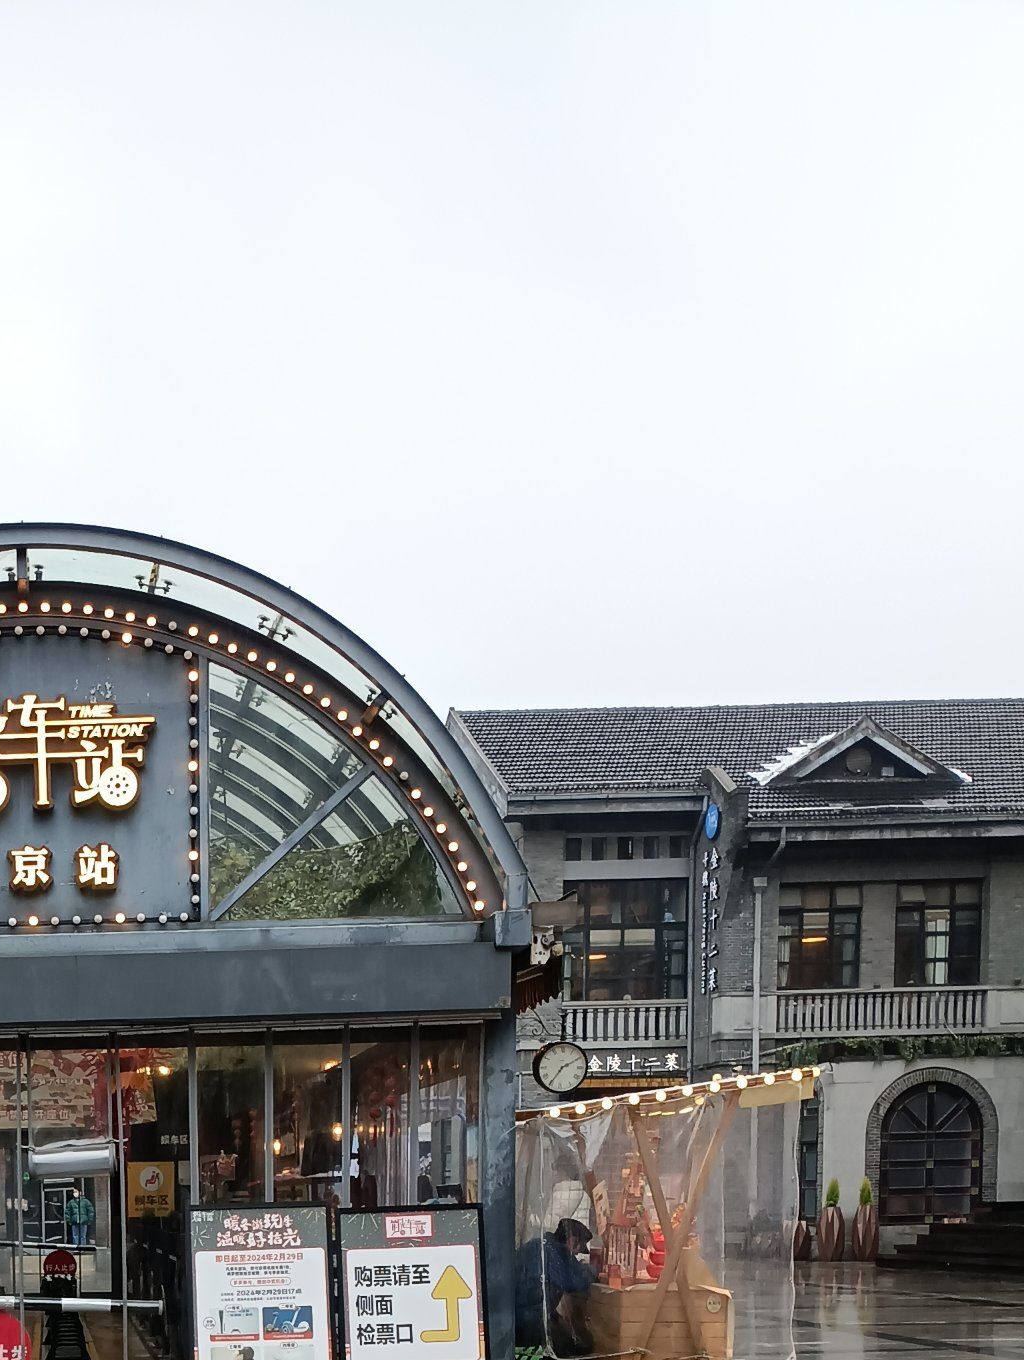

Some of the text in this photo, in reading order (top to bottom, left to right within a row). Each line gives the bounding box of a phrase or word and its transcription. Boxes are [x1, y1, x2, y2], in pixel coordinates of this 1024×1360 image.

[68, 704, 114, 718] TIME
[67, 723, 150, 738] STATION
[709, 847, 719, 991] 金陵十二菜
[587, 1052, 679, 1071] 金陵十二菜
[354, 1264, 431, 1287] 购票请至
[356, 1294, 393, 1317] 侧面
[356, 1323, 414, 1346] 检票口
